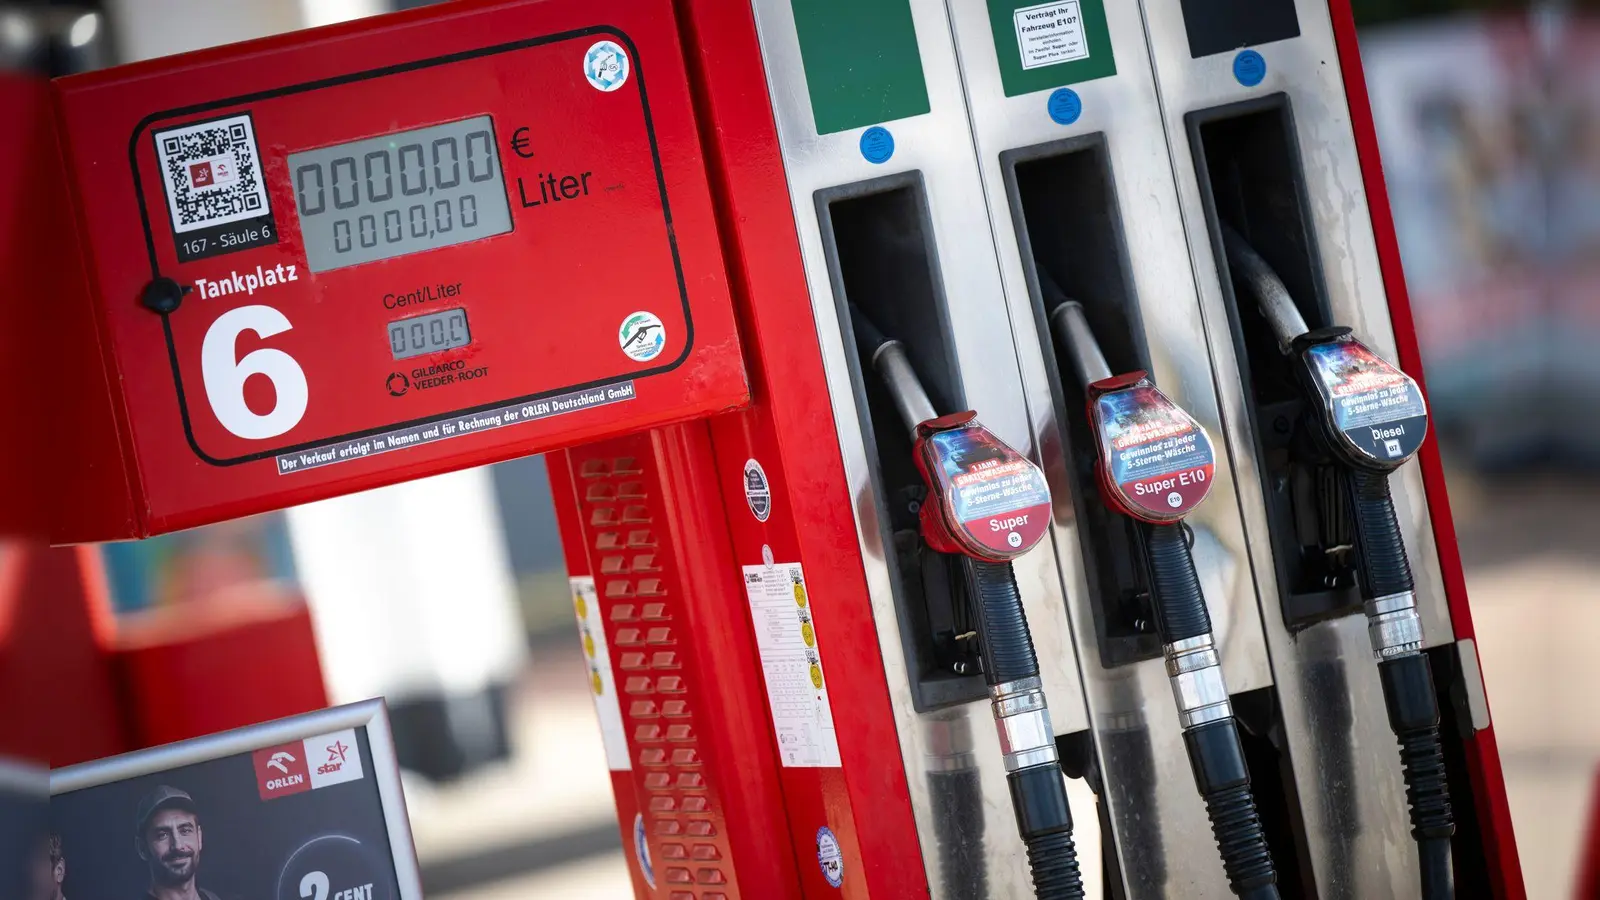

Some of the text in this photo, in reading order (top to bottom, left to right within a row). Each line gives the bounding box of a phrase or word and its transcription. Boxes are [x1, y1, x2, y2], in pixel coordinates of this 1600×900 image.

[1021, 16, 1077, 33] Fahrzeug E10?
[1026, 7, 1068, 21] Verträgt Ihr
[510, 126, 534, 158] €
[517, 171, 592, 208] Liter
[183, 238, 207, 254] 167
[221, 228, 259, 248] Säule
[261, 225, 271, 238] 6
[195, 263, 299, 300] Tankplatz
[382, 282, 462, 310] Cent/Liter
[201, 304, 309, 439] 6
[411, 360, 465, 379] GILBARCO
[413, 366, 489, 390] VEEDER-ROOT
[1341, 385, 1408, 408] Gewinnlos zu jeder
[281, 385, 633, 470] Der Verkauf erfolgt im Namen und für Rechnung der ORLEN Deutschland GmbH
[1372, 424, 1405, 440] Diesel
[1120, 434, 1197, 460] Gewinnlos zu jeder
[1127, 444, 1196, 469] 5-Sterne-Wäsche
[979, 460, 998, 470] JAHR
[960, 482, 1000, 498] Gewinnlos
[1012, 474, 1033, 486] jeder
[1134, 477, 1176, 496] Super
[1179, 469, 1206, 486] E10
[967, 484, 1033, 507] 5-Sterne-Wäsche
[989, 514, 1029, 532] Super
[317, 762, 342, 775] star
[266, 773, 304, 790] ORLEN
[299, 870, 330, 900] 2
